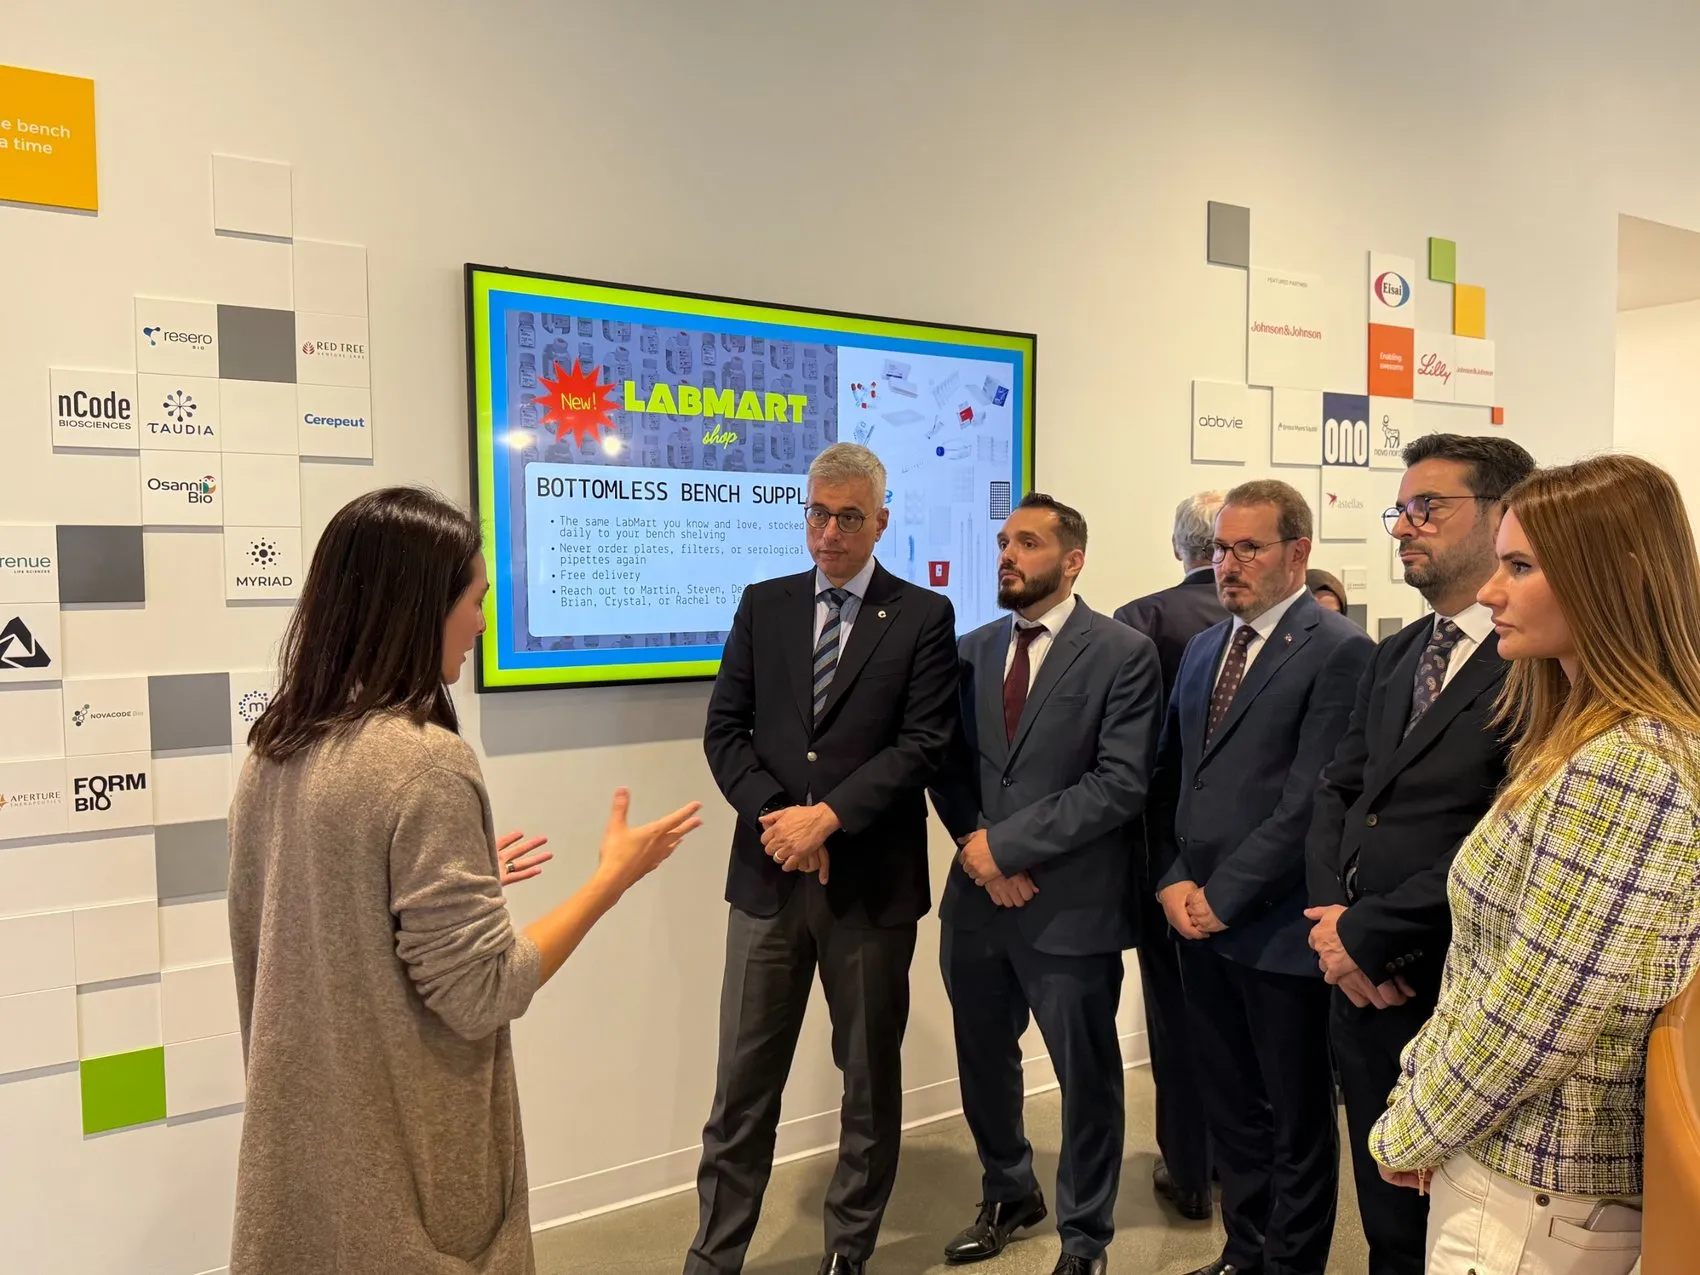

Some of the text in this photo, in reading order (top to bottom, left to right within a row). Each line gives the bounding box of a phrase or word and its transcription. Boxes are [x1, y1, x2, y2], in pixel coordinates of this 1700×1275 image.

[17, 118, 70, 138] bench
[13, 138, 52, 154] time
[1383, 282, 1402, 296] Eisai
[1251, 321, 1322, 340] Johnson&Johnson
[164, 331, 213, 345] resero
[316, 341, 365, 354] RED TREE
[1417, 353, 1452, 385] Lilly
[58, 391, 132, 420] nCode
[561, 392, 597, 411] New!
[624, 380, 808, 424] LABMART
[58, 419, 132, 431] BIOSCIENCES
[304, 413, 365, 428] Cerepeut
[1199, 415, 1243, 429] abbvie
[147, 422, 215, 436] TAUDIA
[702, 424, 738, 449] shop
[1374, 448, 1402, 457] novo nord
[147, 478, 202, 492] Osanni
[537, 477, 806, 505] BOTTOMLESS BENCH SUPPL
[188, 492, 213, 504] Bio
[560, 515, 805, 531] The same LabMart you know and love, stocked
[560, 527, 726, 541] daily to your bench shelving
[560, 543, 804, 556] Never order plates, filters, or serological
[0, 557, 51, 568] renue
[560, 555, 647, 566] pipettes again
[236, 576, 293, 587] MYRIAD
[560, 569, 641, 582] Free delivery
[560, 584, 746, 596] Reach out to Martin, Steven, De
[561, 596, 597, 607] Brian,
[605, 596, 651, 608] Crystal,
[658, 597, 670, 605] or
[676, 595, 709, 605] Rachel
[716, 596, 726, 604] to
[249, 697, 268, 712] mi
[90, 711, 132, 719] NOVACODE
[74, 773, 146, 796] FORM
[10, 791, 61, 802] APERTURE
[75, 796, 111, 812] BIO
